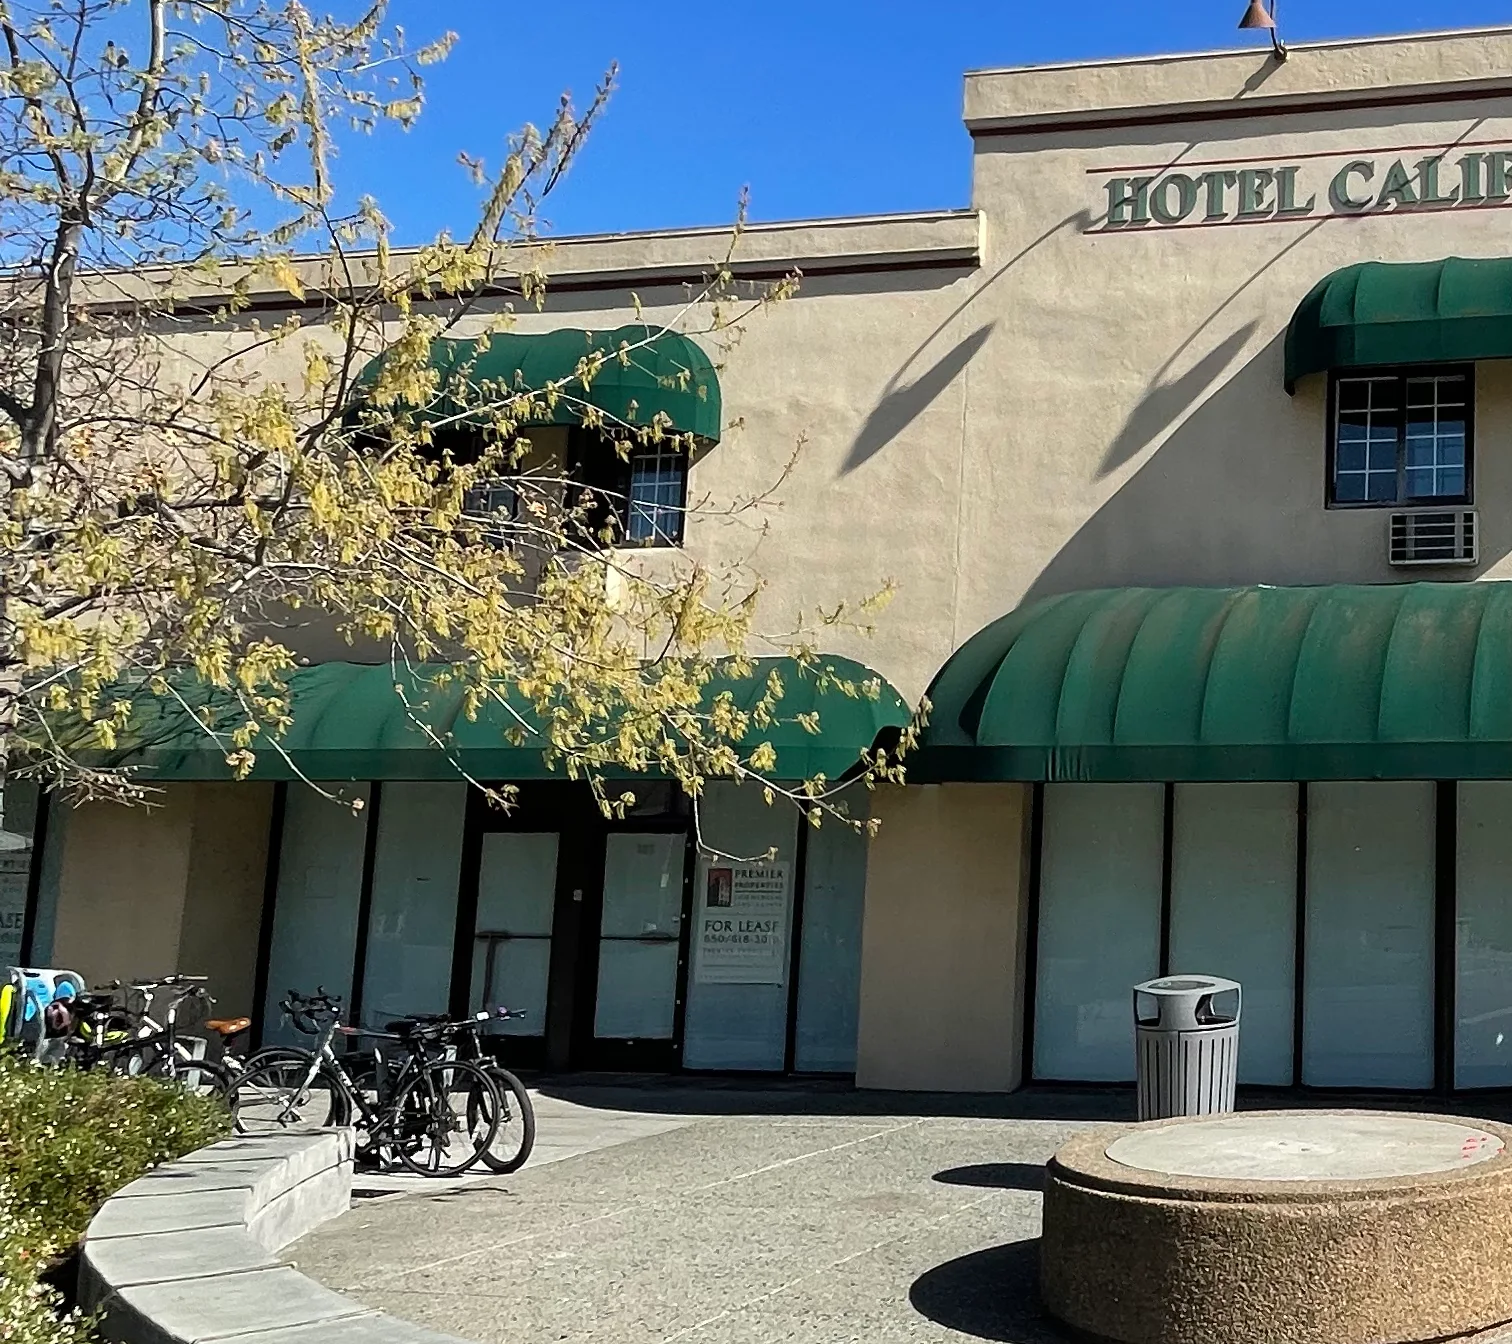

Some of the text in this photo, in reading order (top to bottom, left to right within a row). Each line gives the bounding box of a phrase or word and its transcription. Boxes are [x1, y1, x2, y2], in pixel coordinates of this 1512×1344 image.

[1102, 164, 1315, 228] HOTEL
[705, 920, 780, 933] FOR LEASE
